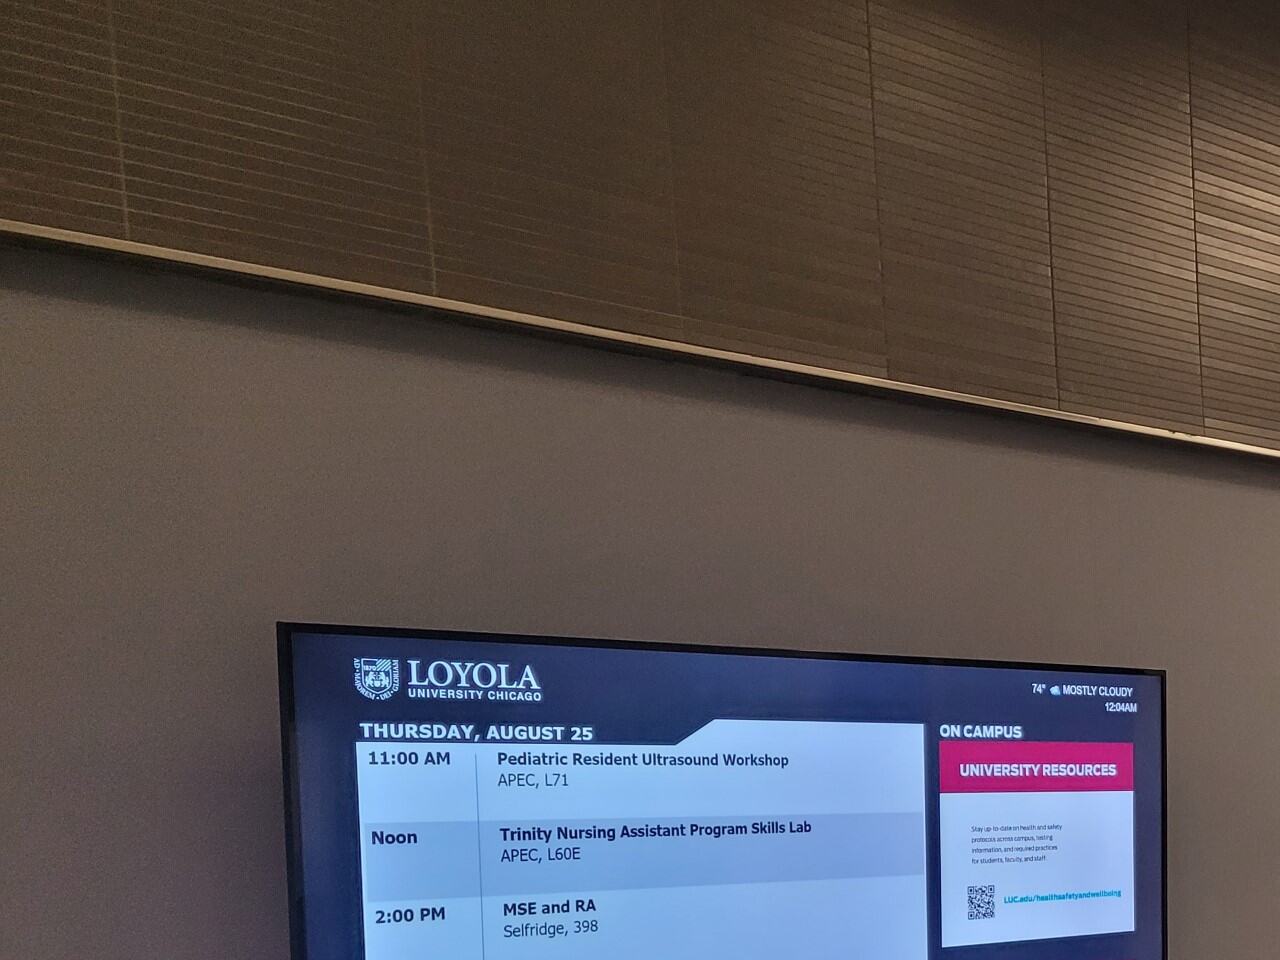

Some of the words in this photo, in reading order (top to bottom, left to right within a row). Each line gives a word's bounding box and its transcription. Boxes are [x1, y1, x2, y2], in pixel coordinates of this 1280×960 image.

[407, 659, 541, 689] LOYOLA
[408, 688, 483, 700] UNIVERSITY
[487, 690, 542, 701] CHICAGO
[1063, 685, 1097, 696] MOSTLY
[1099, 686, 1133, 697] CLOUDY
[1105, 702, 1137, 712] 12:04AM
[359, 722, 480, 742] THURSDAY,
[486, 725, 565, 741] AUGUST
[570, 727, 593, 741] 25
[939, 724, 961, 738] ON
[963, 725, 1023, 739] CAMPUS
[368, 751, 420, 766] 11:00
[424, 751, 451, 766] AM
[497, 752, 568, 766] Pediatric
[573, 752, 638, 766] Resident
[642, 752, 718, 766] Ultrasound
[723, 753, 789, 768] Workshop
[959, 763, 1040, 777] UNIVERSITY
[1042, 763, 1117, 776] RESOURCES
[497, 773, 539, 789] APEC,
[545, 773, 569, 787] L71
[499, 827, 552, 843] Trinity
[557, 825, 616, 841] Nursing
[620, 823, 686, 838] Assistant
[690, 823, 748, 838] Program
[751, 821, 786, 834] Skills
[790, 820, 812, 833] Lab
[1047, 823, 1062, 831] safety
[371, 830, 418, 845] Noon
[500, 848, 543, 864] APEC,
[547, 847, 581, 861] L60E
[1035, 844, 1058, 852] practices
[503, 902, 537, 916] MSE
[542, 900, 570, 914] and
[576, 899, 596, 912] RA
[375, 909, 414, 924] 2:00
[420, 907, 446, 921] PM
[503, 921, 569, 938] Selfridge,
[573, 920, 599, 933] 398
